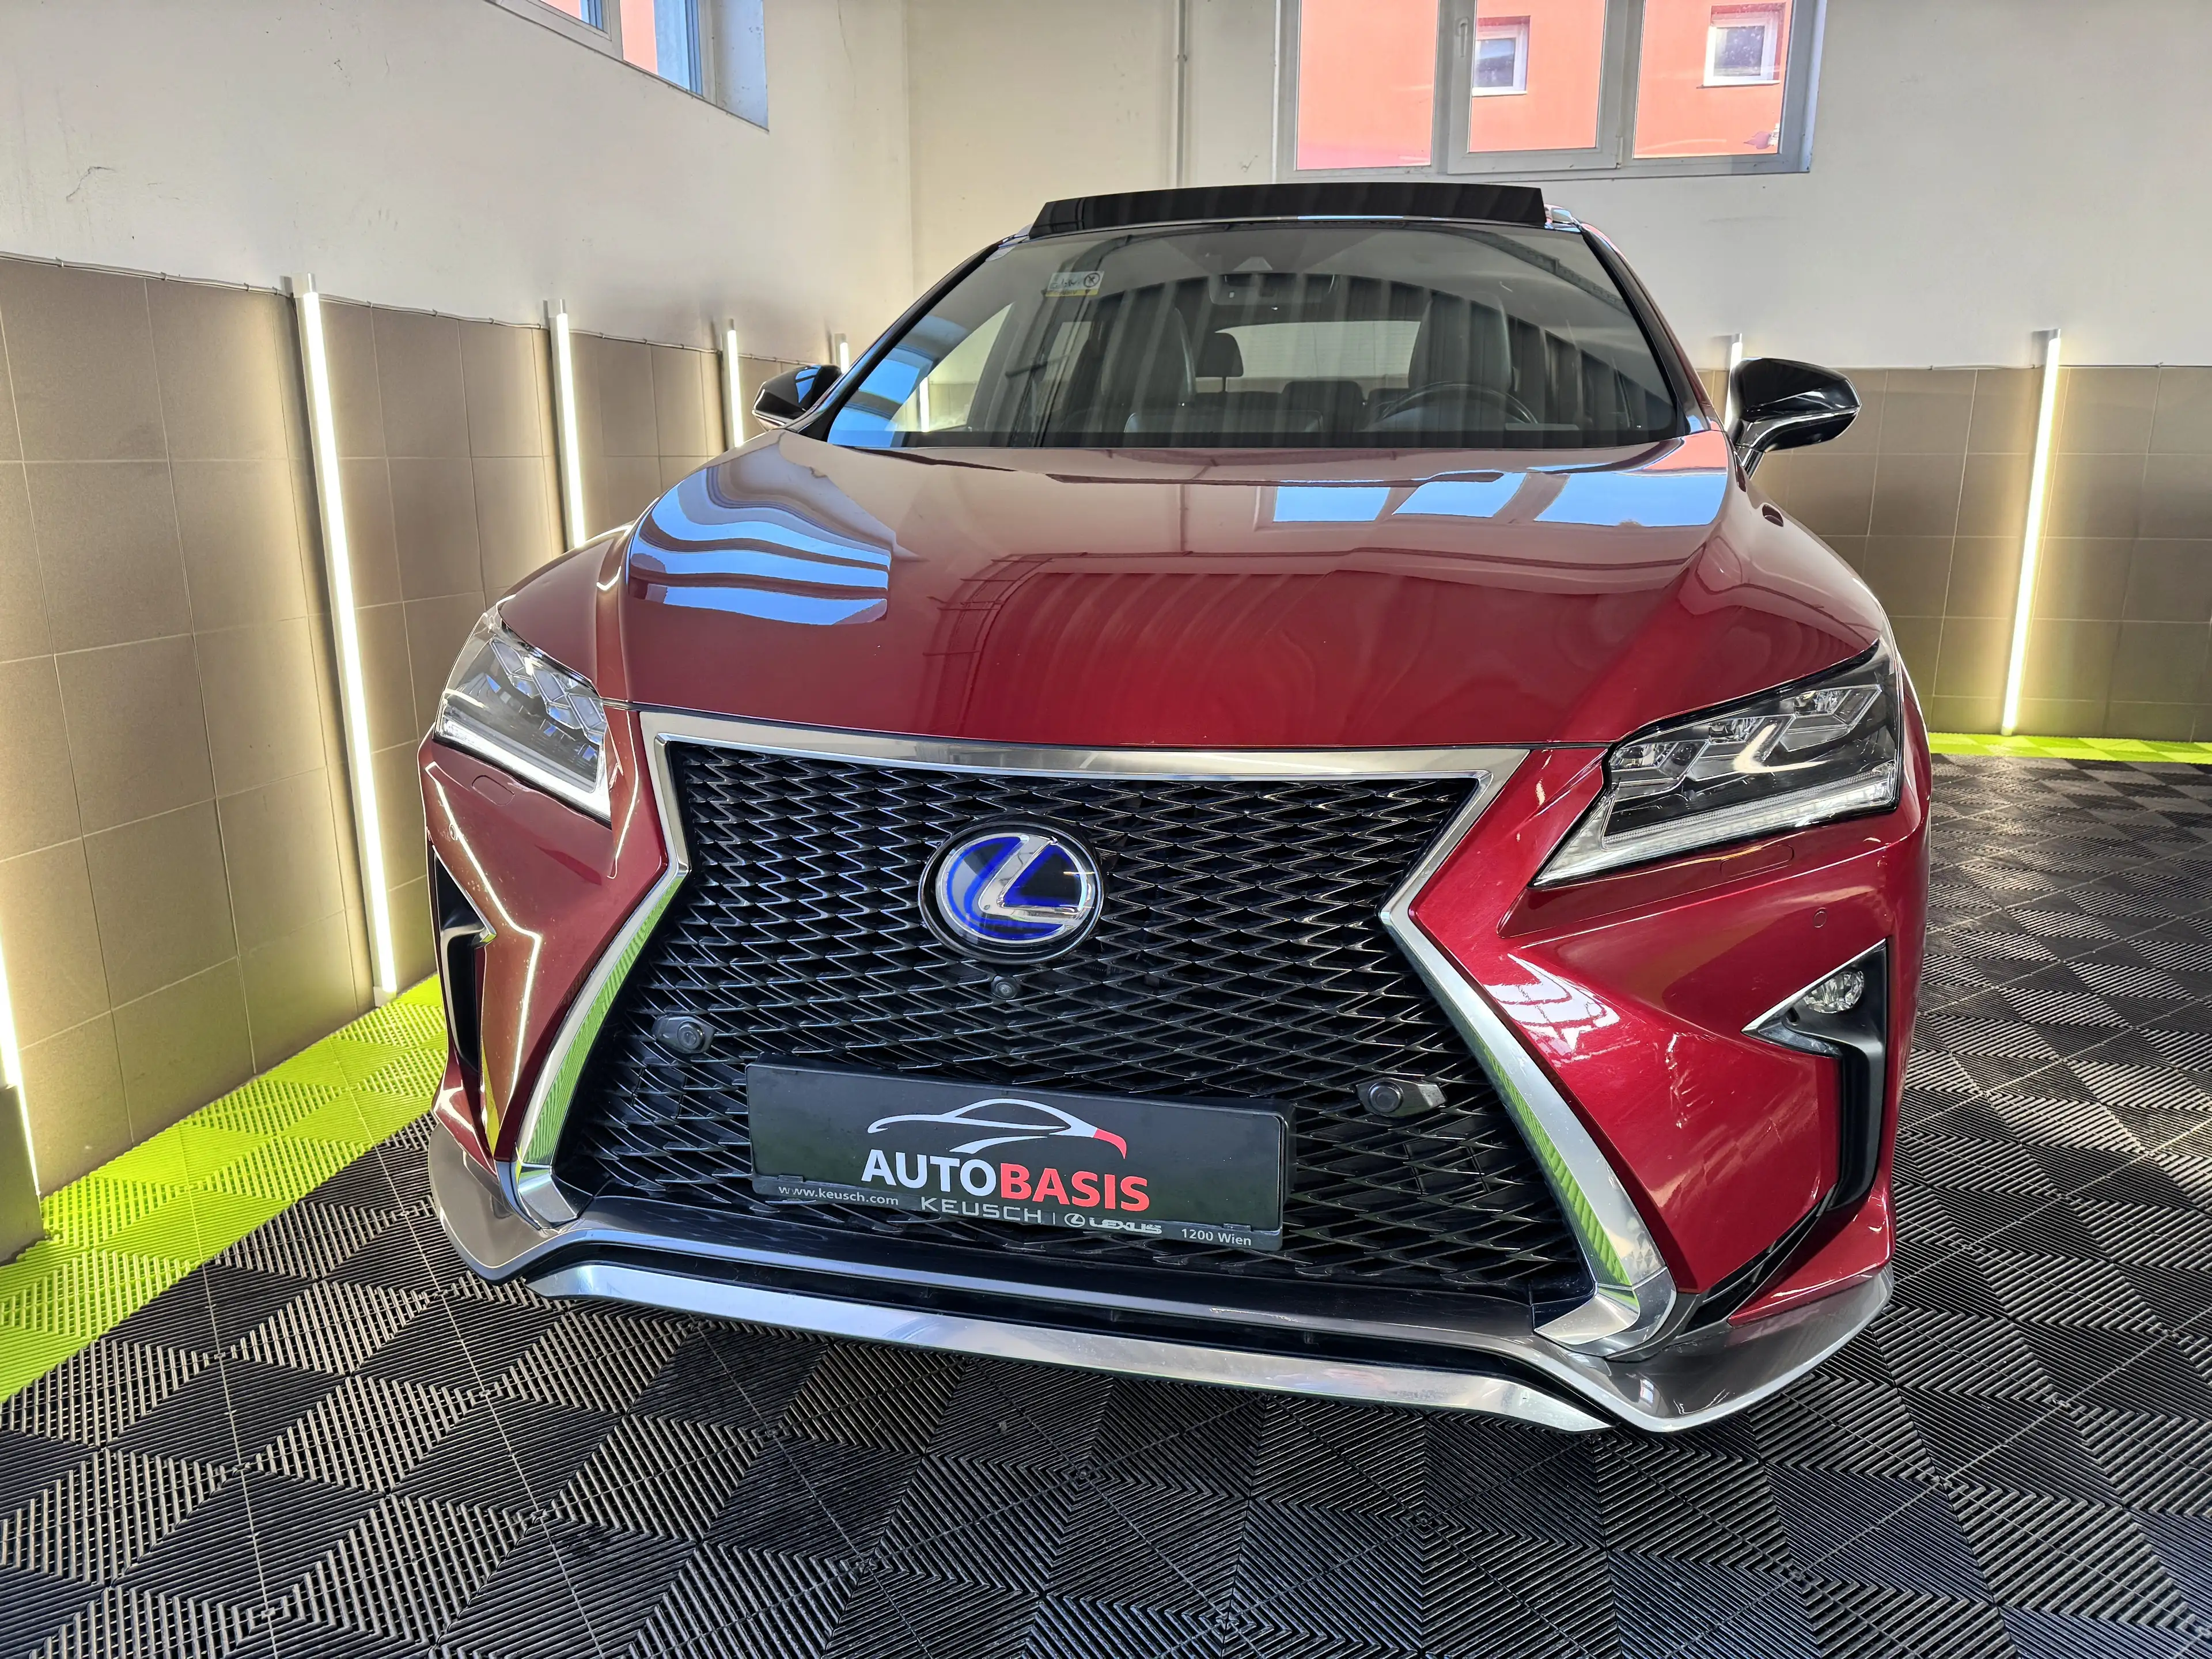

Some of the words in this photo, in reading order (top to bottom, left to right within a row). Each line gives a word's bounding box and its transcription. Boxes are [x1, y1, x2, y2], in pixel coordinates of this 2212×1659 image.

[861, 1149, 1150, 1211] AUTOBASIS
[778, 1186, 899, 1205] www.keusch.com
[921, 1196, 1041, 1224] KEUSCH
[1089, 1217, 1162, 1234] LEXUS
[1181, 1228, 1214, 1241] 1200
[1218, 1232, 1251, 1246] Wien
